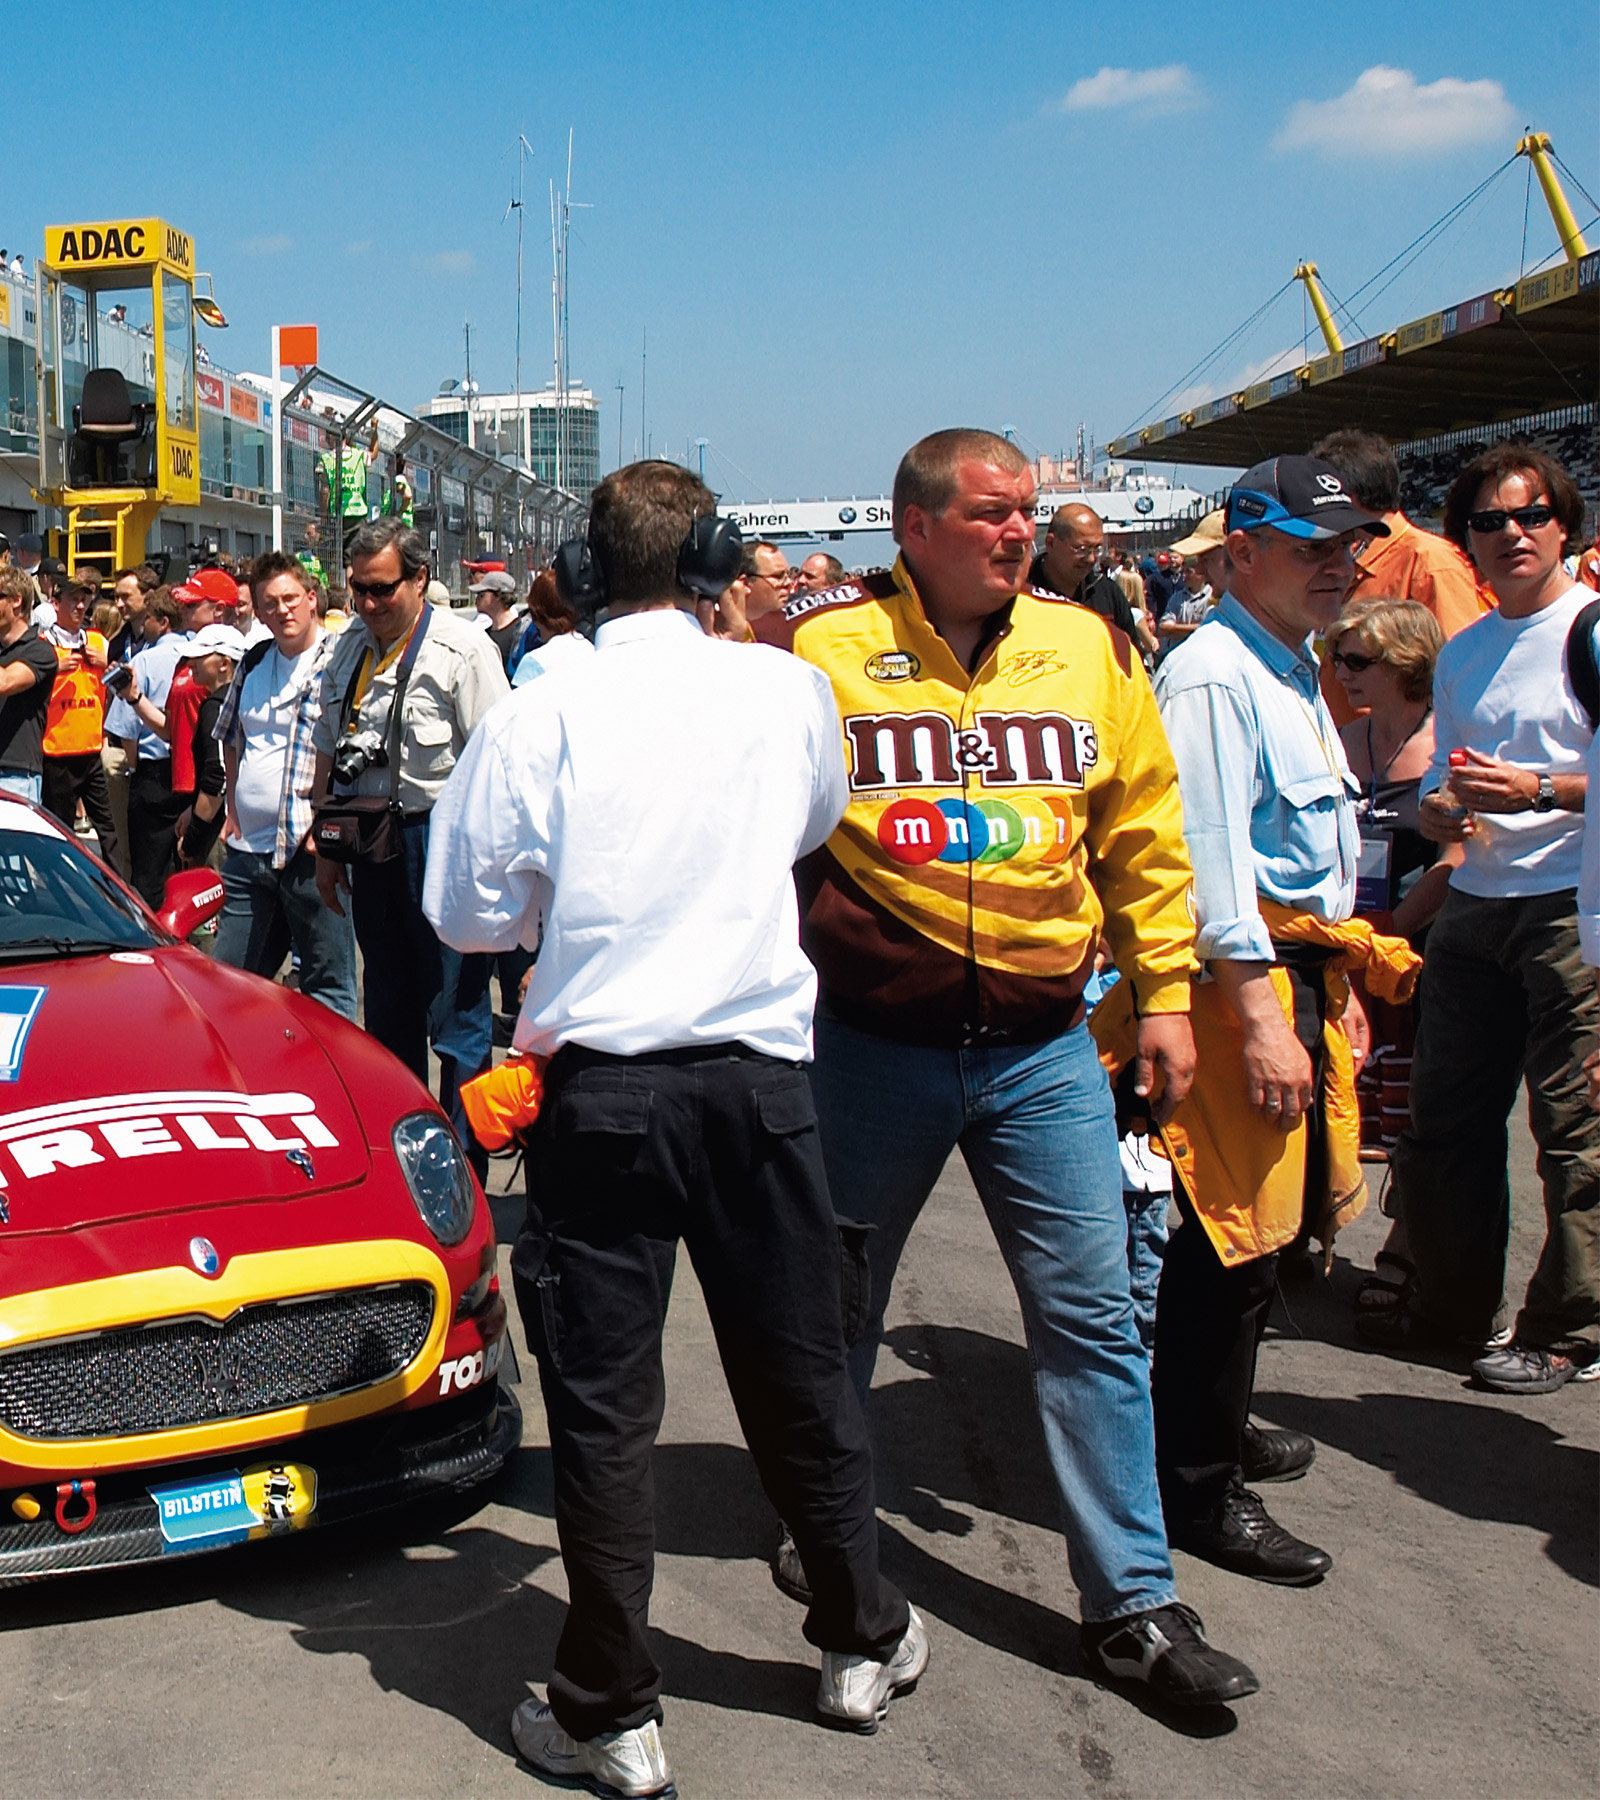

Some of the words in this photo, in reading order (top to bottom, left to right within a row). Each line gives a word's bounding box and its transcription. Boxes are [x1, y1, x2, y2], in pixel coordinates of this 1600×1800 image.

[59, 227, 145, 262] ADAC
[166, 229, 189, 266] ADAC
[728, 512, 789, 527] Fahren
[61, 698, 96, 710] TEAM
[322, 830, 340, 840] EOS
[164, 1486, 242, 1518] BILSTEIN
